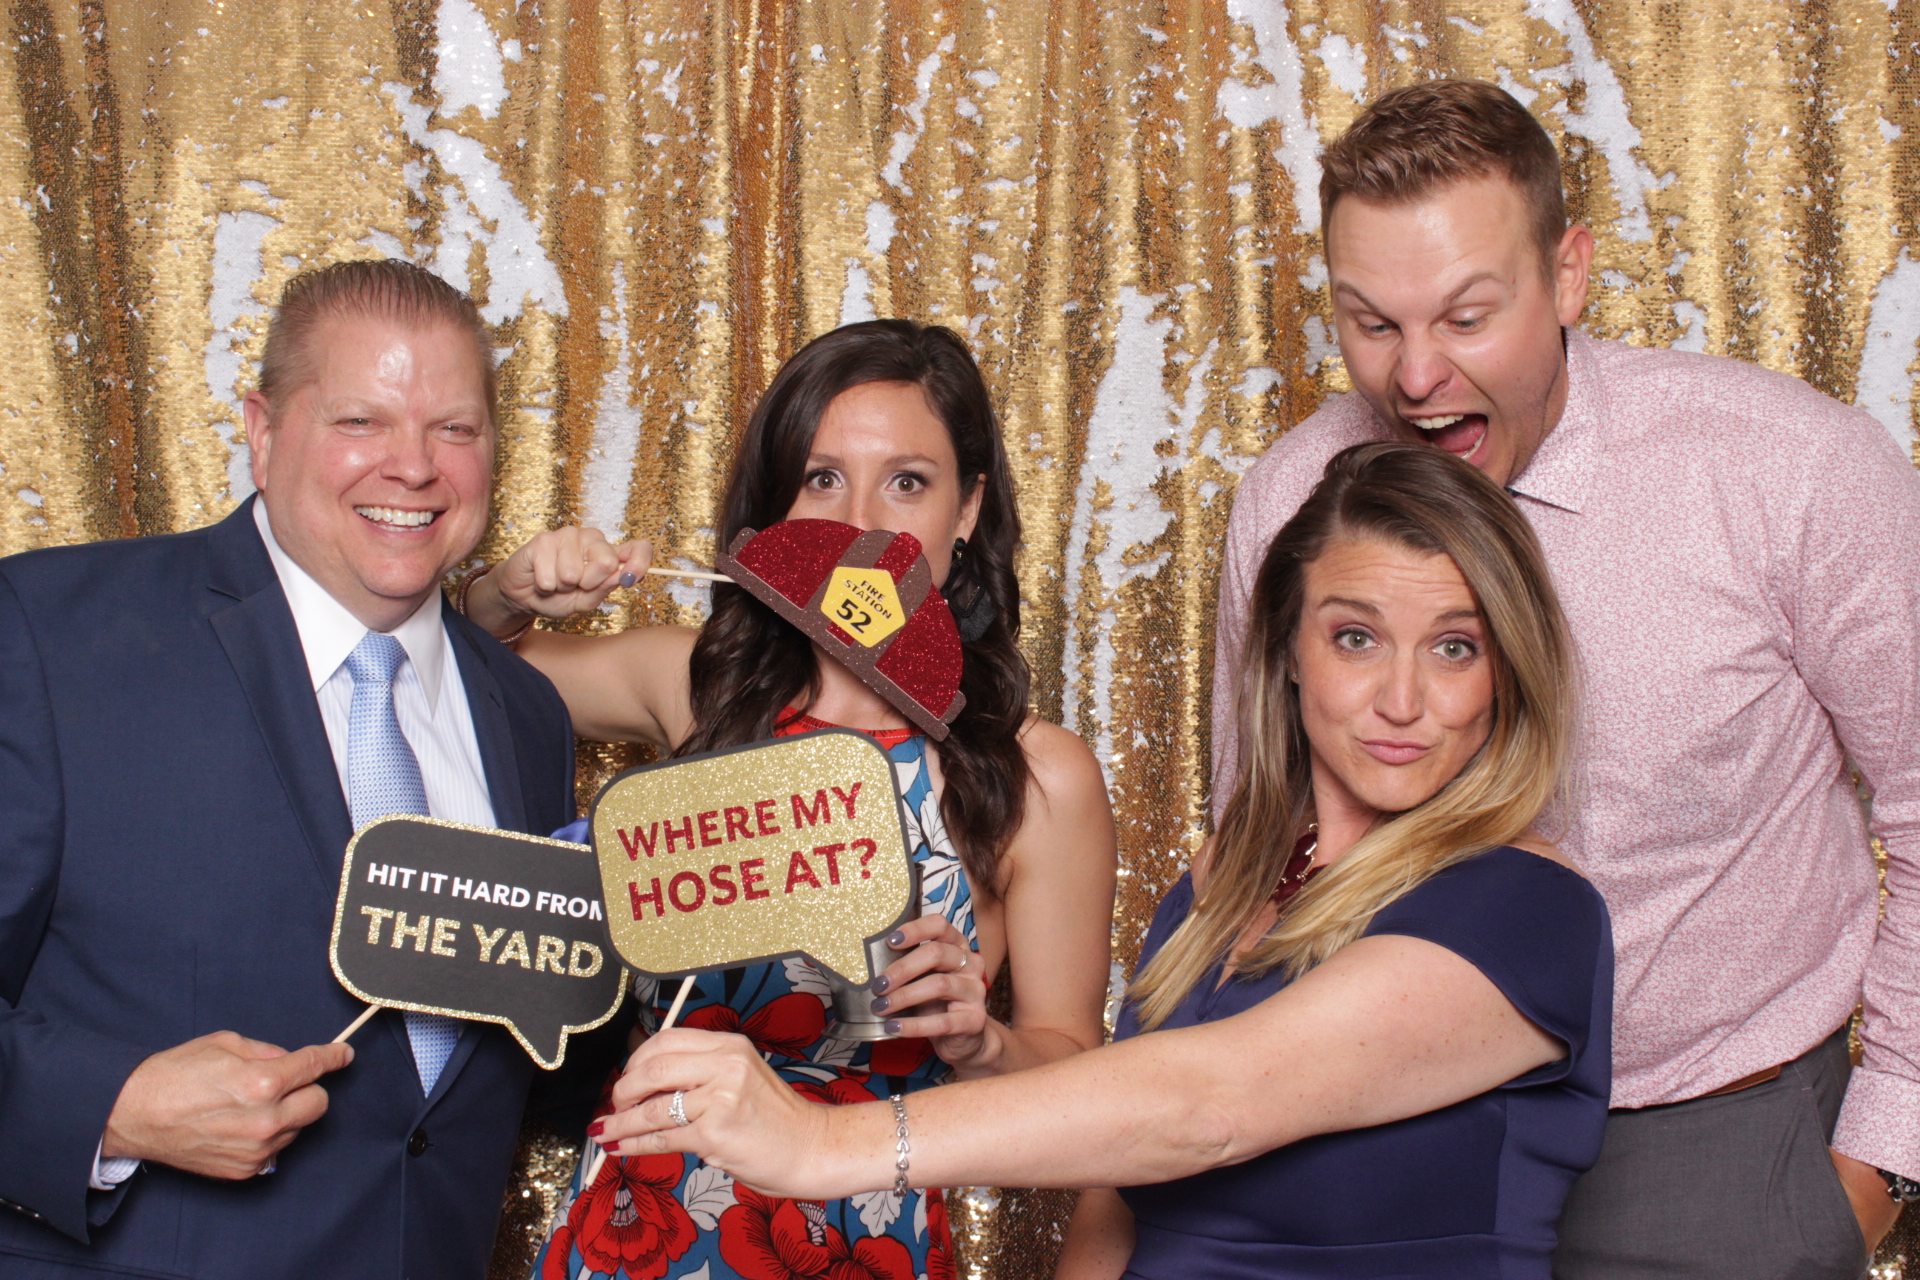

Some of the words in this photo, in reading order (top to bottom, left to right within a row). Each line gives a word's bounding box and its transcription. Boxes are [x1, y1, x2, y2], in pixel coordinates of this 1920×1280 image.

[844, 579, 892, 619] STATION
[860, 580, 886, 600] FIRE
[836, 598, 872, 634] 52
[617, 799, 781, 862] WHERE
[790, 782, 862, 830] MY
[367, 862, 416, 889] HIT
[420, 871, 448, 894] IT
[452, 876, 530, 908] HARD
[628, 857, 770, 922] HOSE
[784, 837, 877, 894] AT?
[361, 905, 461, 957] THE
[473, 923, 603, 978] YARD
